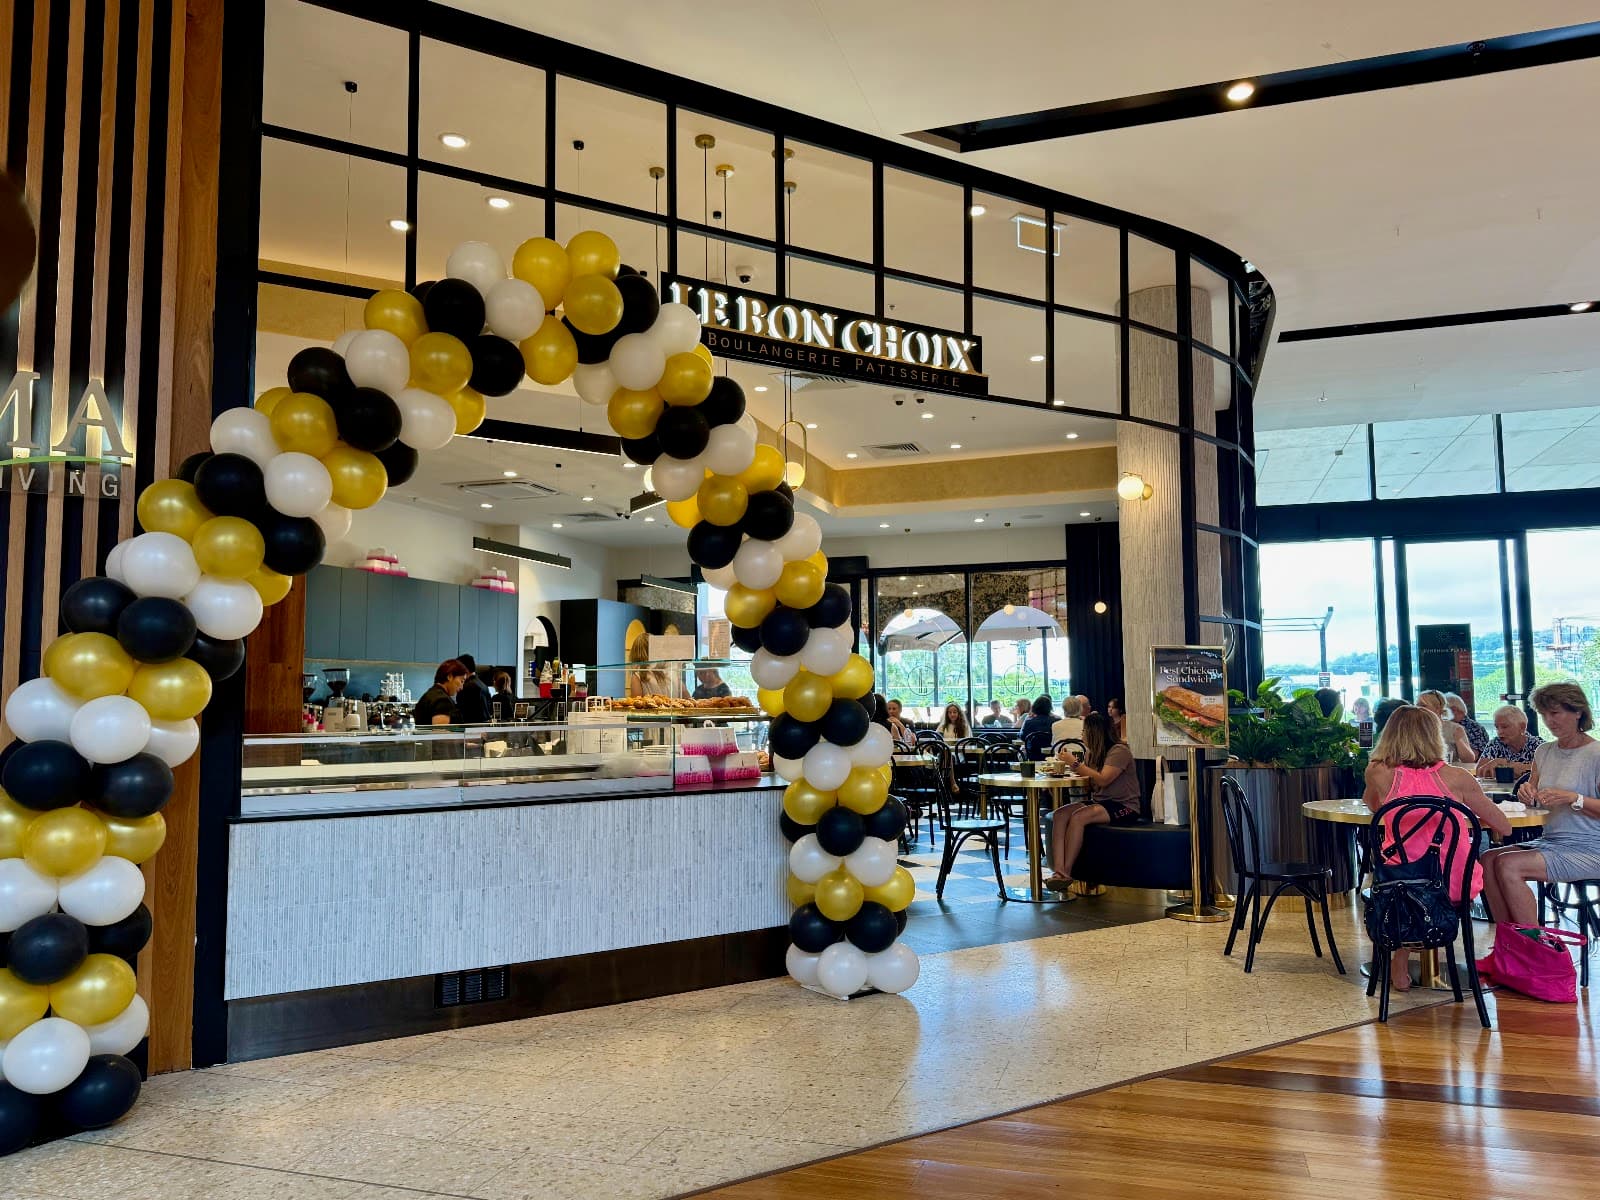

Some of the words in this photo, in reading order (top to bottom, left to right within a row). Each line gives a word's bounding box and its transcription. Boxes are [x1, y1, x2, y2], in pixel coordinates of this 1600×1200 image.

[736, 295, 838, 349] BON
[841, 319, 977, 374] CHOIX
[708, 332, 840, 367] BOULANGERIE
[855, 358, 960, 388] PATISSERIE
[1166, 674, 1212, 683] Sandwich
[1180, 666, 1218, 675] Chicken
